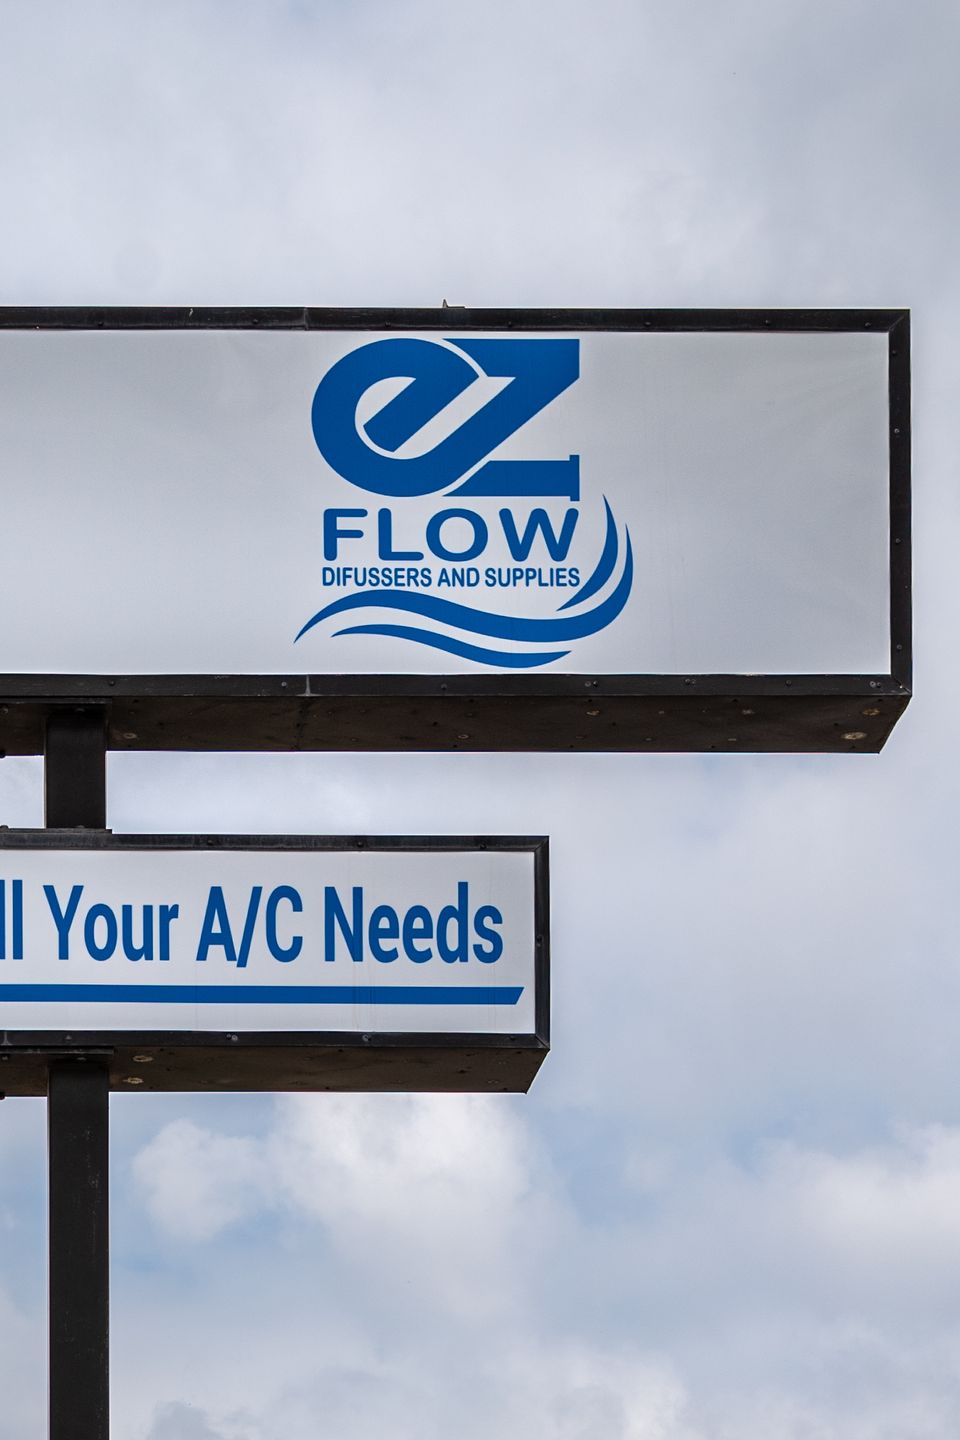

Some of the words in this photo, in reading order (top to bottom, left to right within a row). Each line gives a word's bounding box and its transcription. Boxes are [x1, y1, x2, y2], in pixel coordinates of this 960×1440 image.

[323, 507, 579, 562] FLOW
[322, 566, 432, 588] DIFUSSERS
[437, 567, 480, 588] AND
[484, 567, 581, 588] SUPPLIES
[42, 884, 180, 962] Your
[195, 885, 303, 968] A/C
[324, 881, 504, 964] Needs
